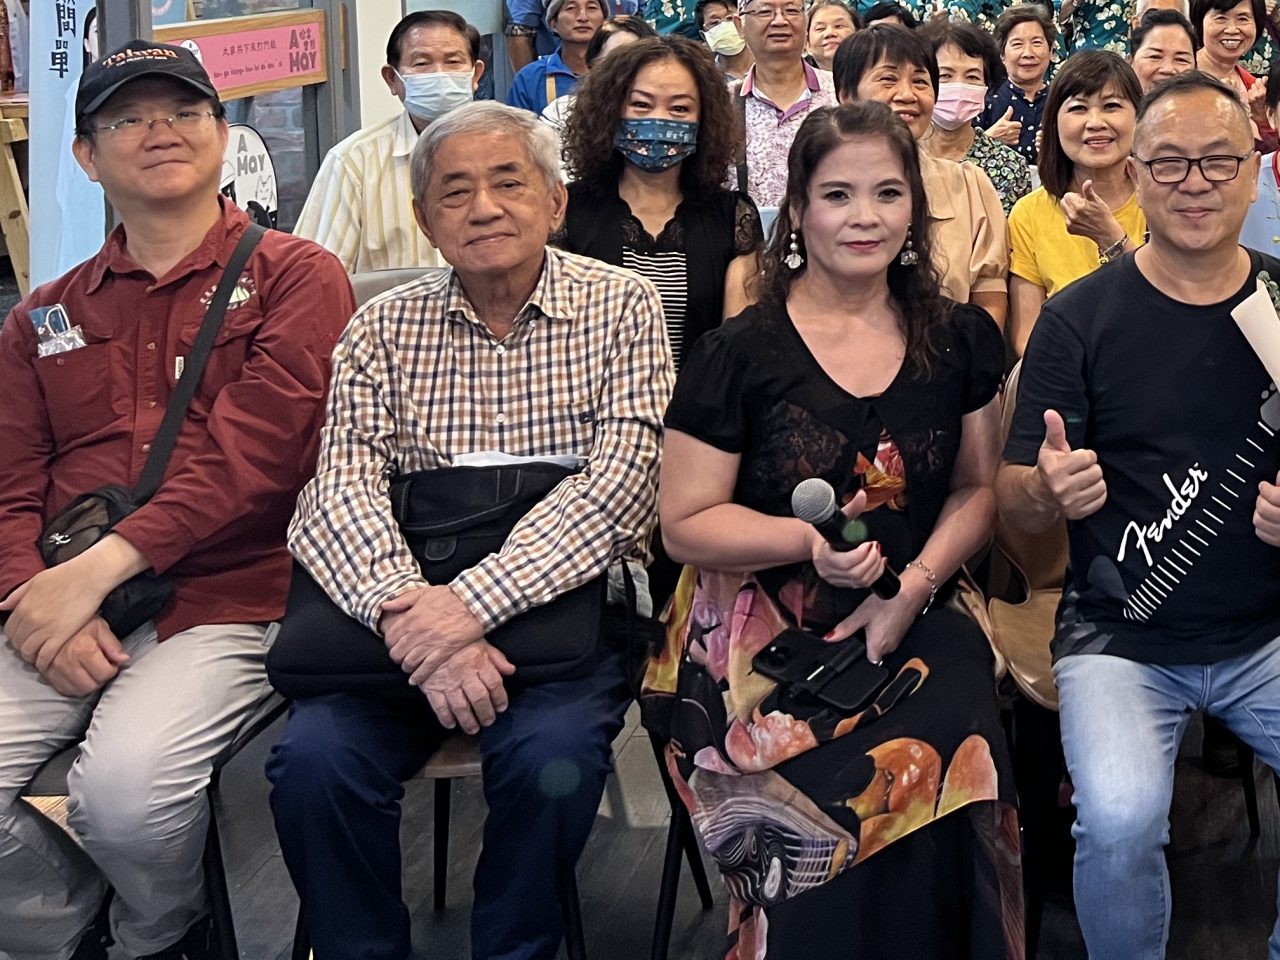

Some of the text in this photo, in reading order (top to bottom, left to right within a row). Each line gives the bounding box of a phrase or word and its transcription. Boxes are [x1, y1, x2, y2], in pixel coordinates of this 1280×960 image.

[102, 48, 178, 68] Taiwan
[237, 133, 248, 154] A
[1117, 461, 1208, 567] Fender
